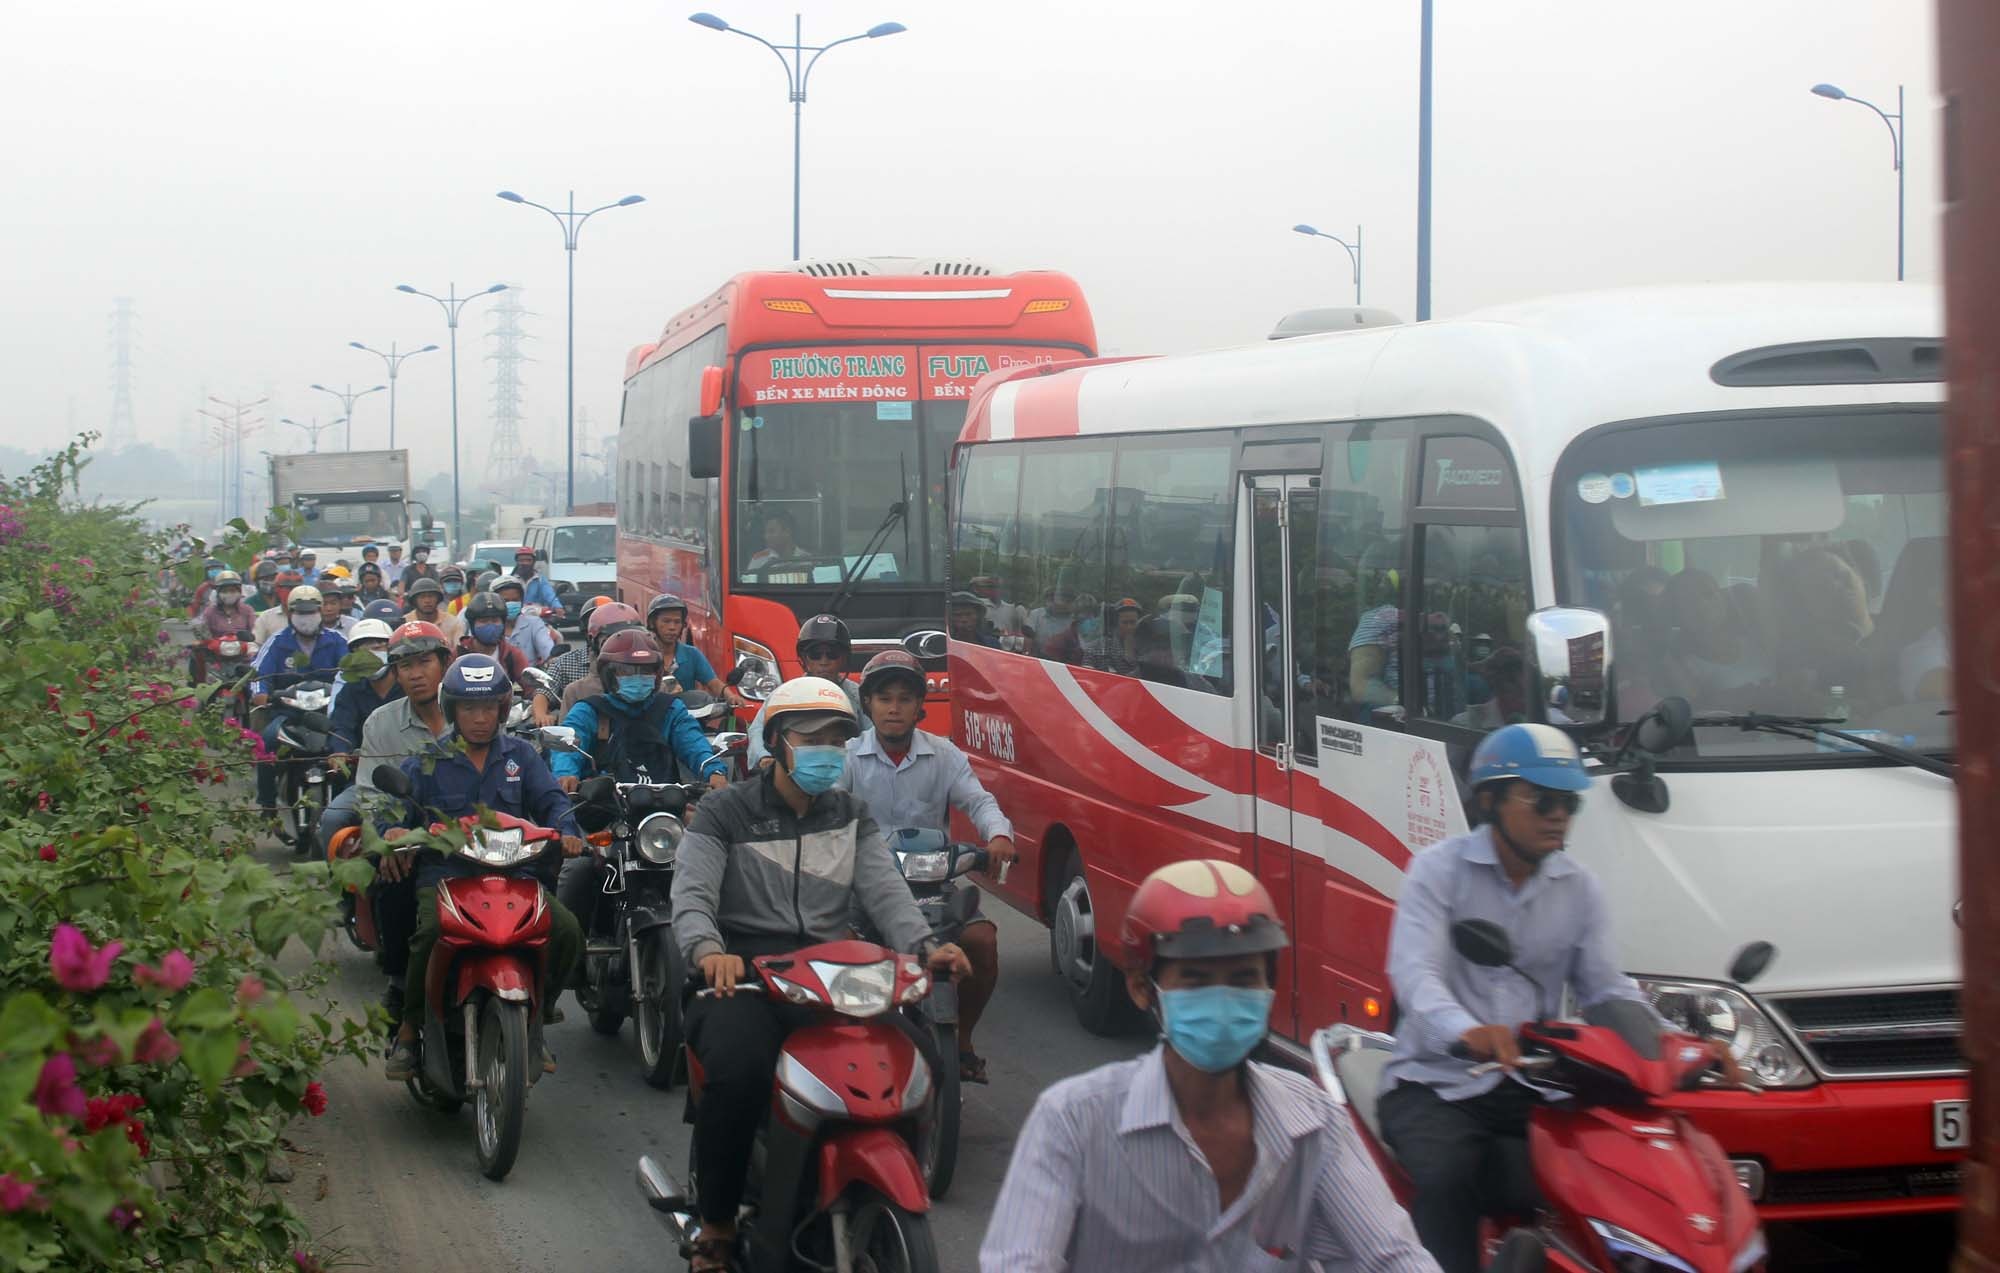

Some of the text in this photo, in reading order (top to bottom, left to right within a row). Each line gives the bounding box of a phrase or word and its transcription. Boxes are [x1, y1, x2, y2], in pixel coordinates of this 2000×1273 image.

[845, 355, 906, 378] TRANG
[928, 355, 991, 378] FUTA
[791, 388, 814, 399] XE
